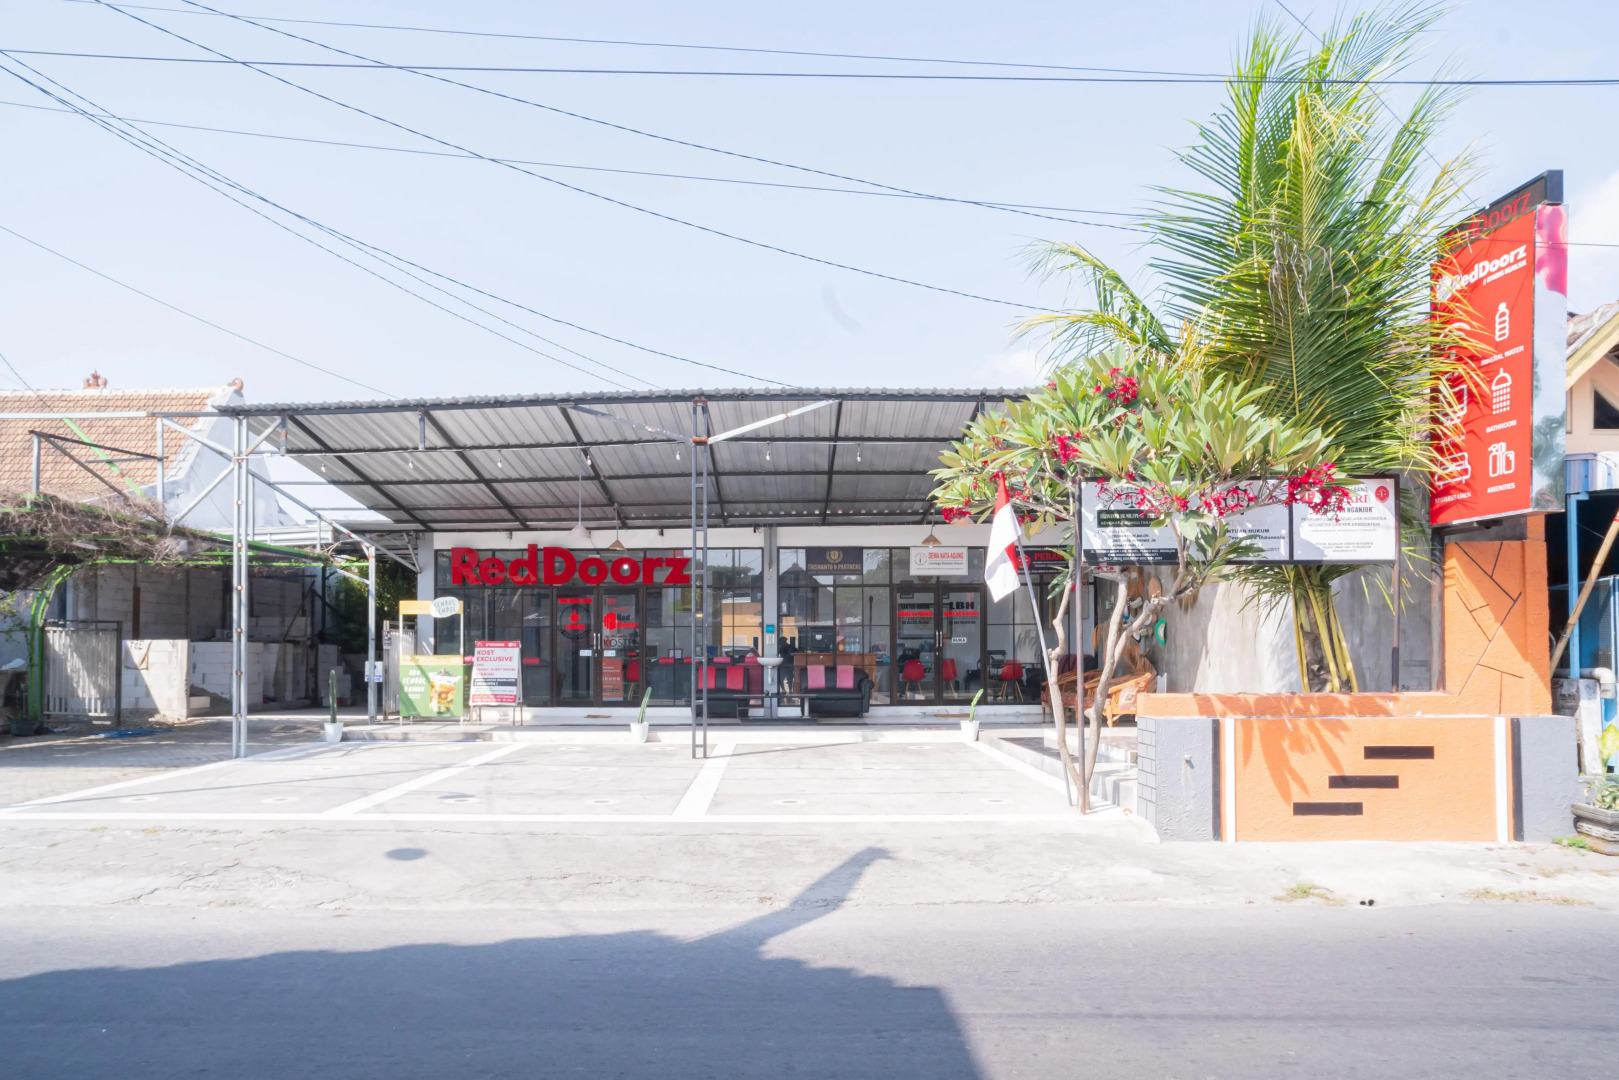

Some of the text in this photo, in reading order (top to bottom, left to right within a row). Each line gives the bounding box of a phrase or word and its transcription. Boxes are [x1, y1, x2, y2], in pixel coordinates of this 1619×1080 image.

[1504, 346, 1524, 358] WATER
[1486, 419, 1517, 433] BATHROOM
[1487, 482, 1516, 493] AMENITIES
[451, 544, 691, 585] RedDoorz
